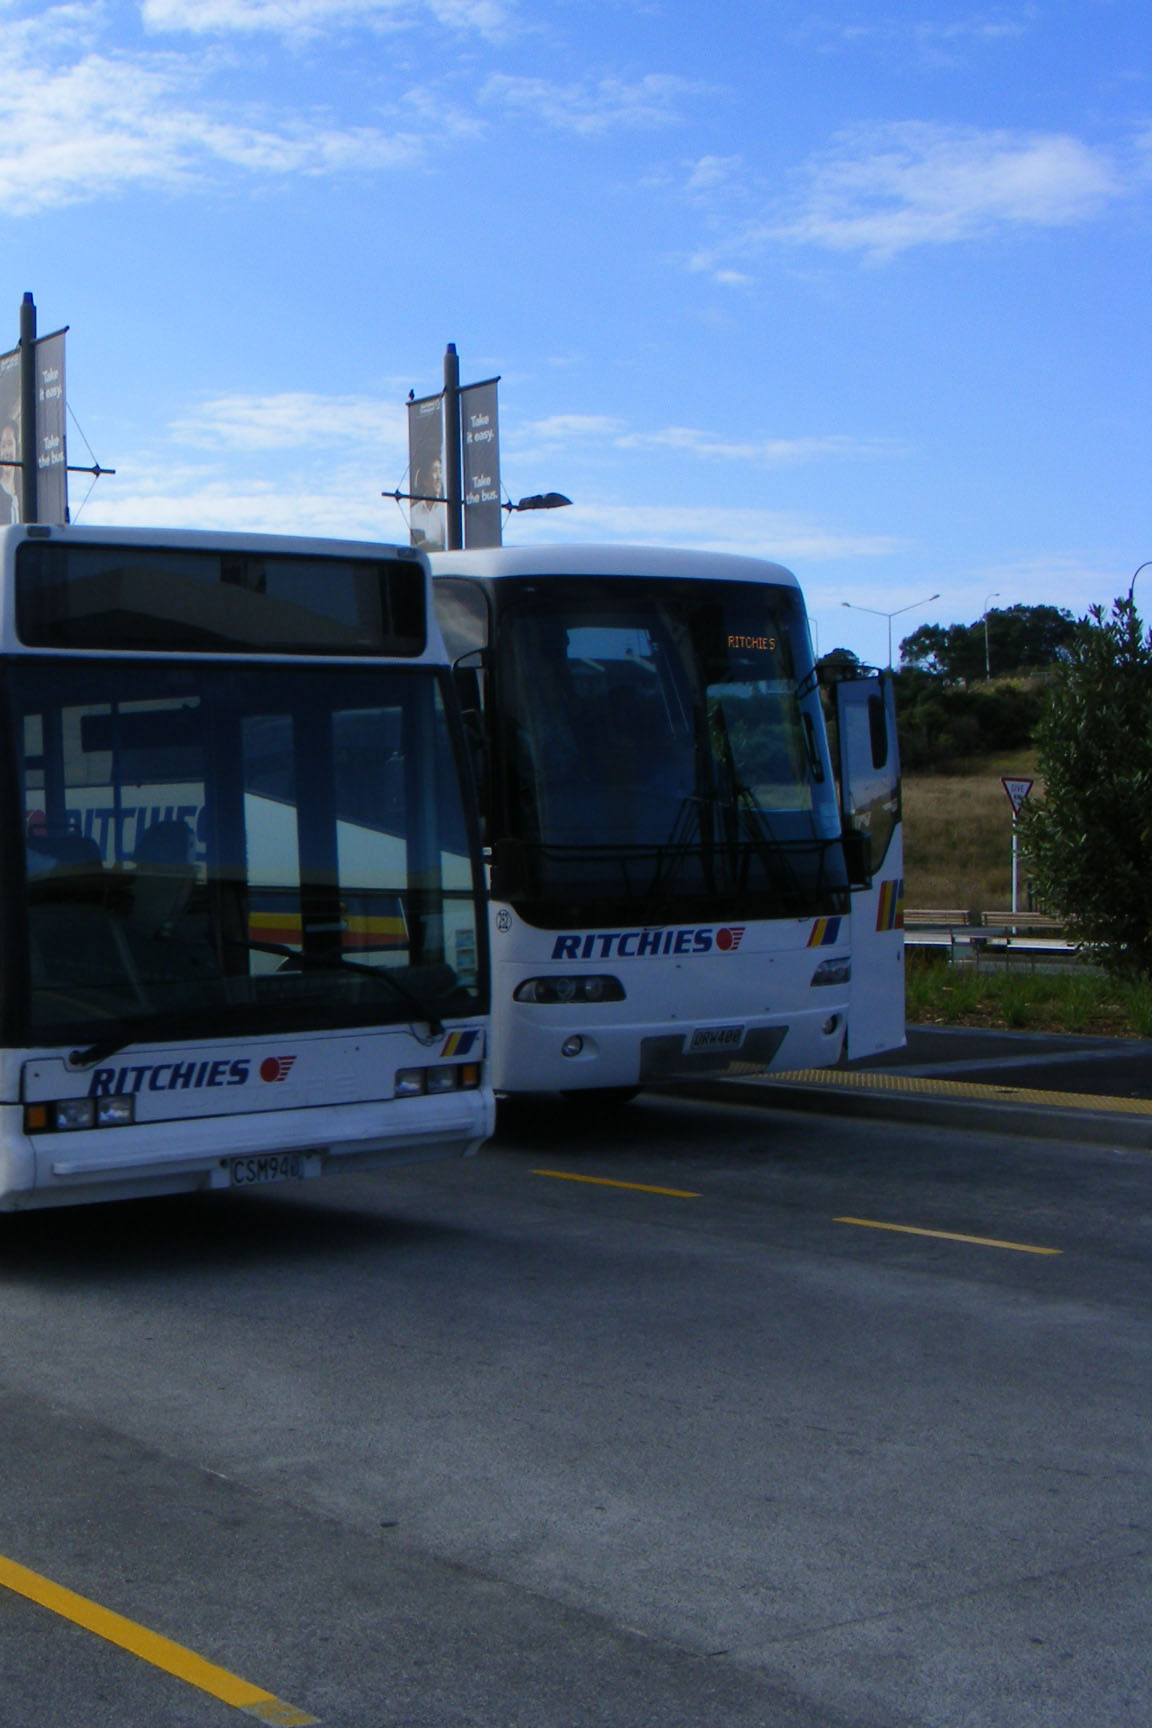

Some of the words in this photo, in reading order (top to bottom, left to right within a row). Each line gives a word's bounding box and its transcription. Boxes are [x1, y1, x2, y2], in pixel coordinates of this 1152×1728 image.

[41, 368, 59, 385] Take
[470, 413, 489, 428] Take
[43, 434, 60, 450] Take
[39, 453, 51, 467] the
[472, 474, 492, 489] Take
[466, 491, 480, 505] the
[728, 635, 776, 650] RITCHIES
[1010, 783, 1025, 793] GIVE
[551, 928, 714, 960] RITCHIES
[88, 1059, 251, 1097] RITCHIES
